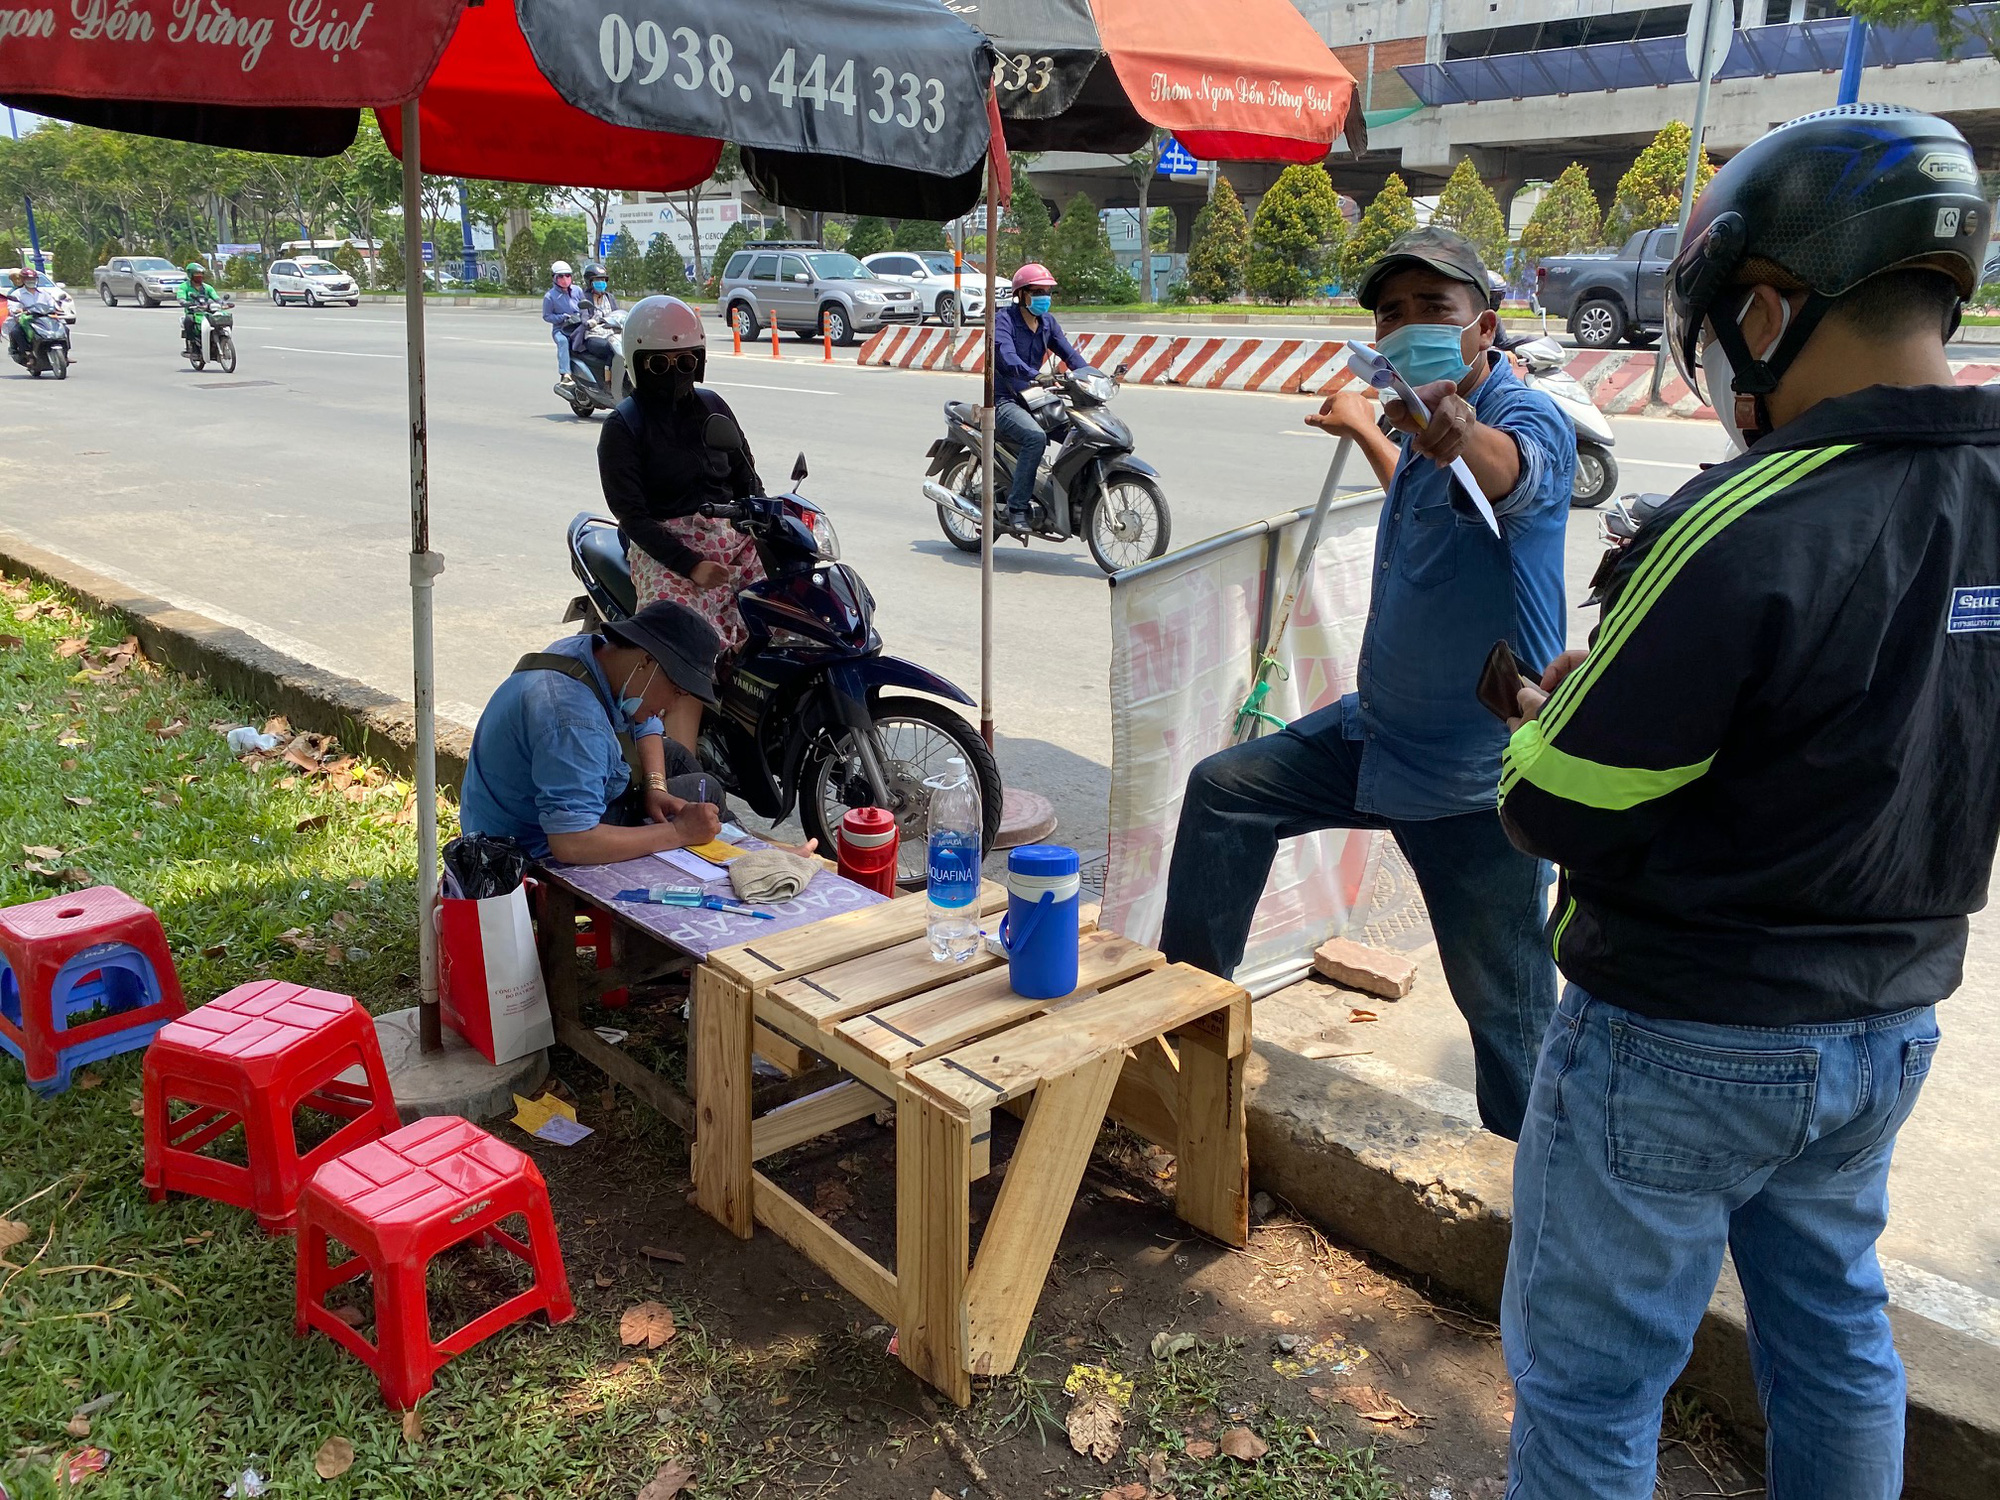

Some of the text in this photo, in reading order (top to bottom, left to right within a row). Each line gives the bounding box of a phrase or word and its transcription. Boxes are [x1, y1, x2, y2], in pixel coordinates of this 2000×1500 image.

[70, 0, 155, 42] Đến
[167, 0, 275, 72] Từng
[289, 0, 374, 63] Giọt
[599, 13, 946, 134] 0938. 444 333
[1150, 72, 1333, 118] Thơm Ngon Đến Từng Giọt
[732, 675, 764, 700] YAMAHA
